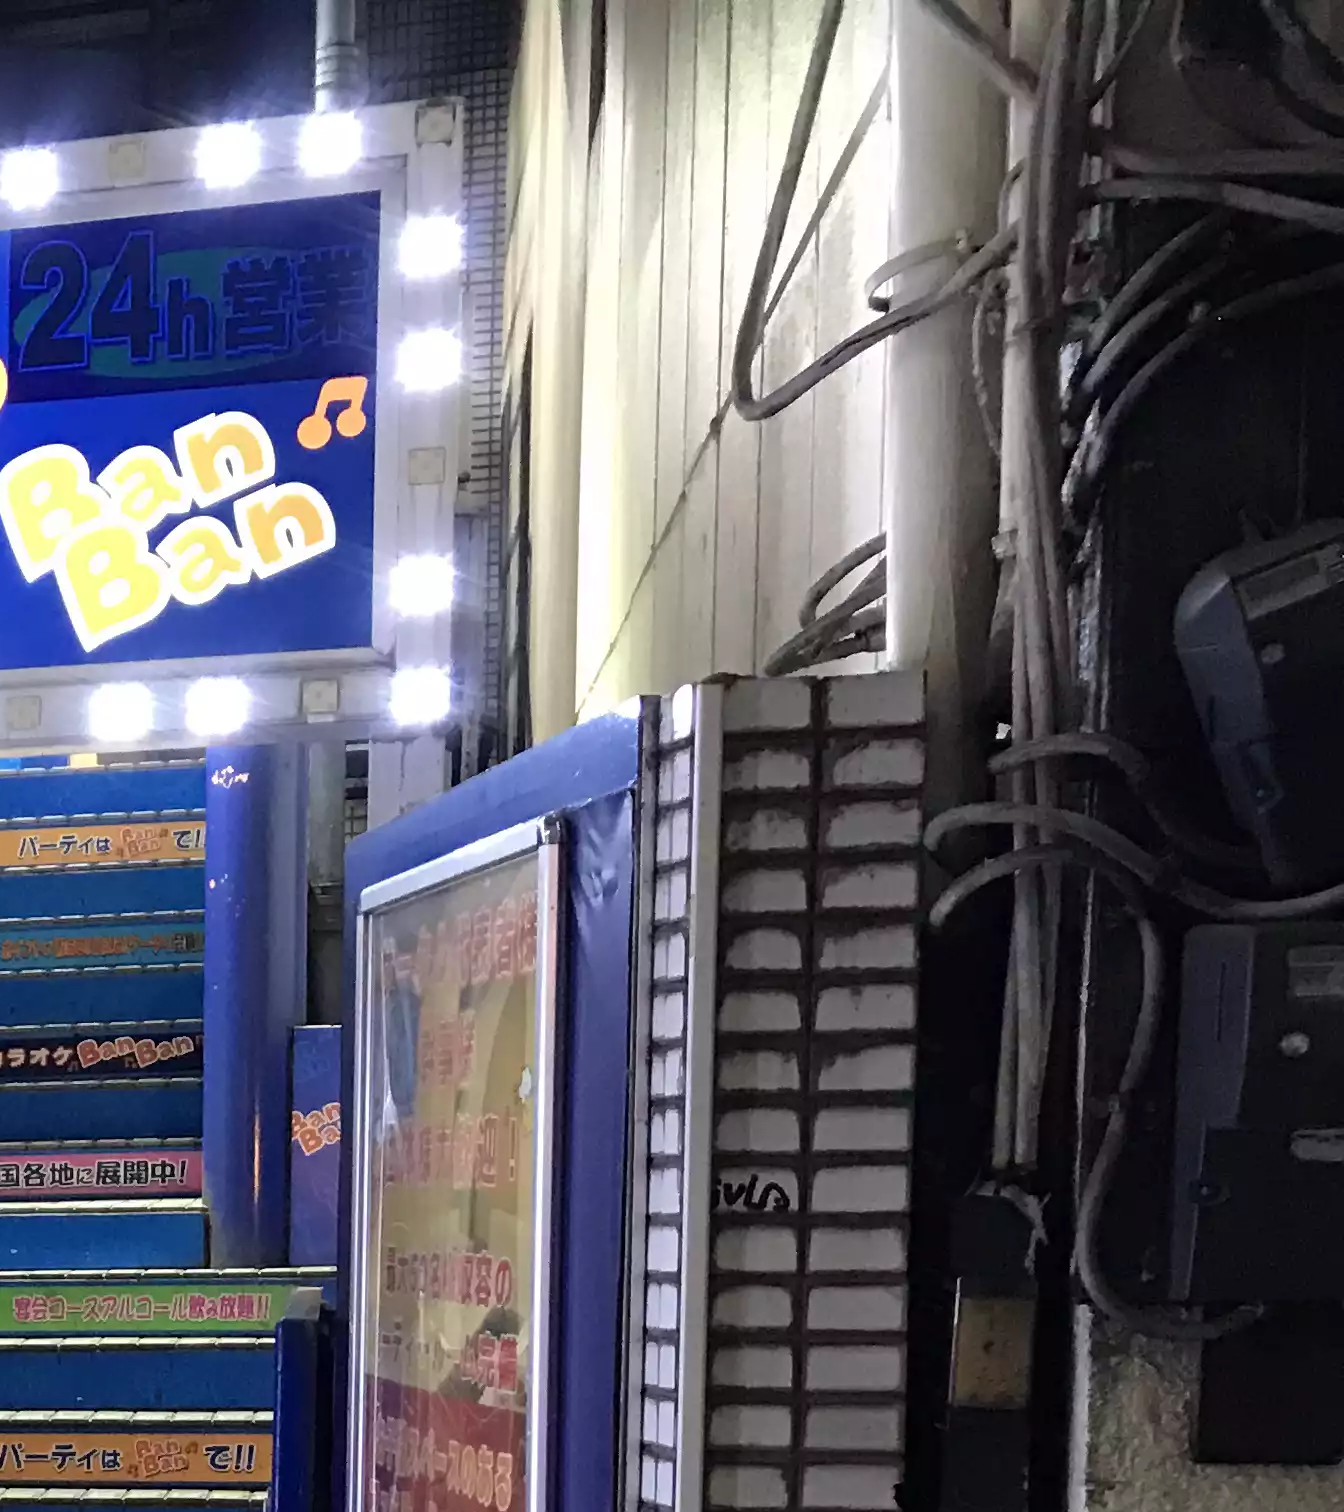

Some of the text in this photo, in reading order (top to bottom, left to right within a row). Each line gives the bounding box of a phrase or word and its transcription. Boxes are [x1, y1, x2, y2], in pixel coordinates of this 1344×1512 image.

[18, 230, 370, 373] 24h営業
[55, 482, 336, 652] Ban
[17, 834, 112, 859] パーティは
[172, 828, 205, 849] で!
[300, 1120, 341, 1156] Ba
